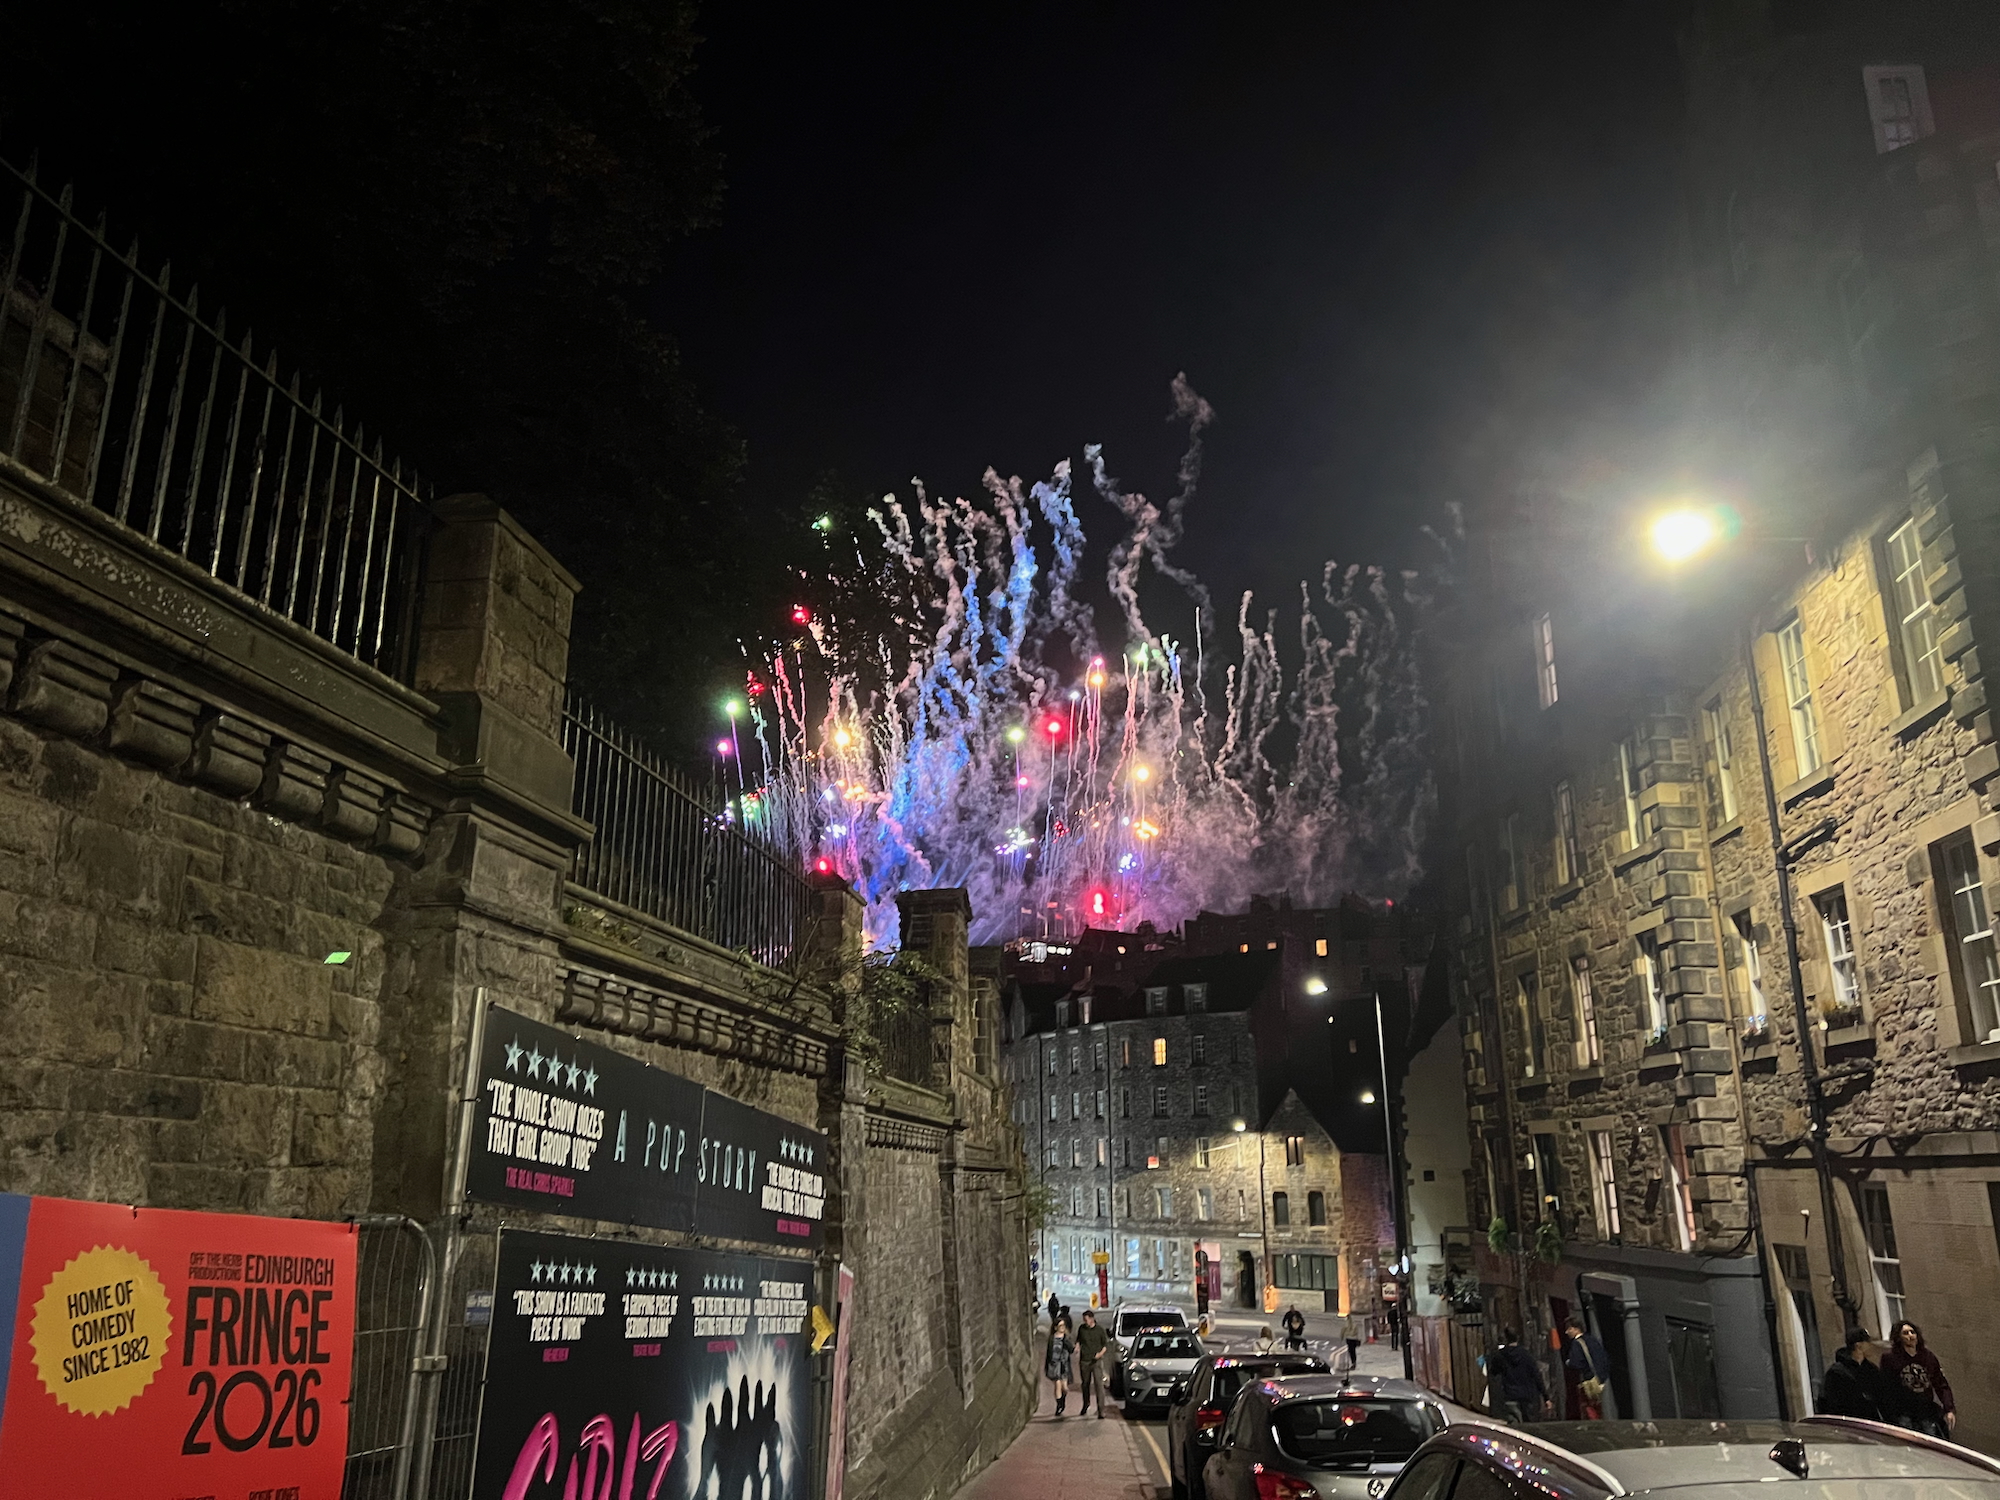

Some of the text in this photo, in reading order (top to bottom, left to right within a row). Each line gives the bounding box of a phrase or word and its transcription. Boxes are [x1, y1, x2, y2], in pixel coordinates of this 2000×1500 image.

[514, 1086, 550, 1126] WHOLE
[548, 1096, 578, 1133] SHOW
[576, 1104, 605, 1141] OOZES
[487, 1117, 517, 1156] THAT
[516, 1124, 538, 1161] GIRL
[539, 1129, 571, 1167] GROUP
[613, 1109, 627, 1163] A
[643, 1119, 686, 1174] POP
[697, 1137, 756, 1194] STORY
[189, 1266, 242, 1281] PRODUCTIONS
[190, 1252, 242, 1267] OFF THE KERB
[244, 1254, 334, 1286] EDINBURGH
[67, 1280, 133, 1319] HOME OF
[534, 1290, 557, 1315] SHOW
[555, 1290, 565, 1315] IS
[563, 1290, 571, 1315] A
[570, 1291, 606, 1316] FANTASTIC
[72, 1309, 135, 1349] COMEDY
[183, 1286, 333, 1367] FRINGE
[529, 1316, 552, 1342] PIECE
[551, 1316, 562, 1341] OF
[63, 1336, 150, 1383] SINCE 1982
[181, 1368, 321, 1455] 2026
